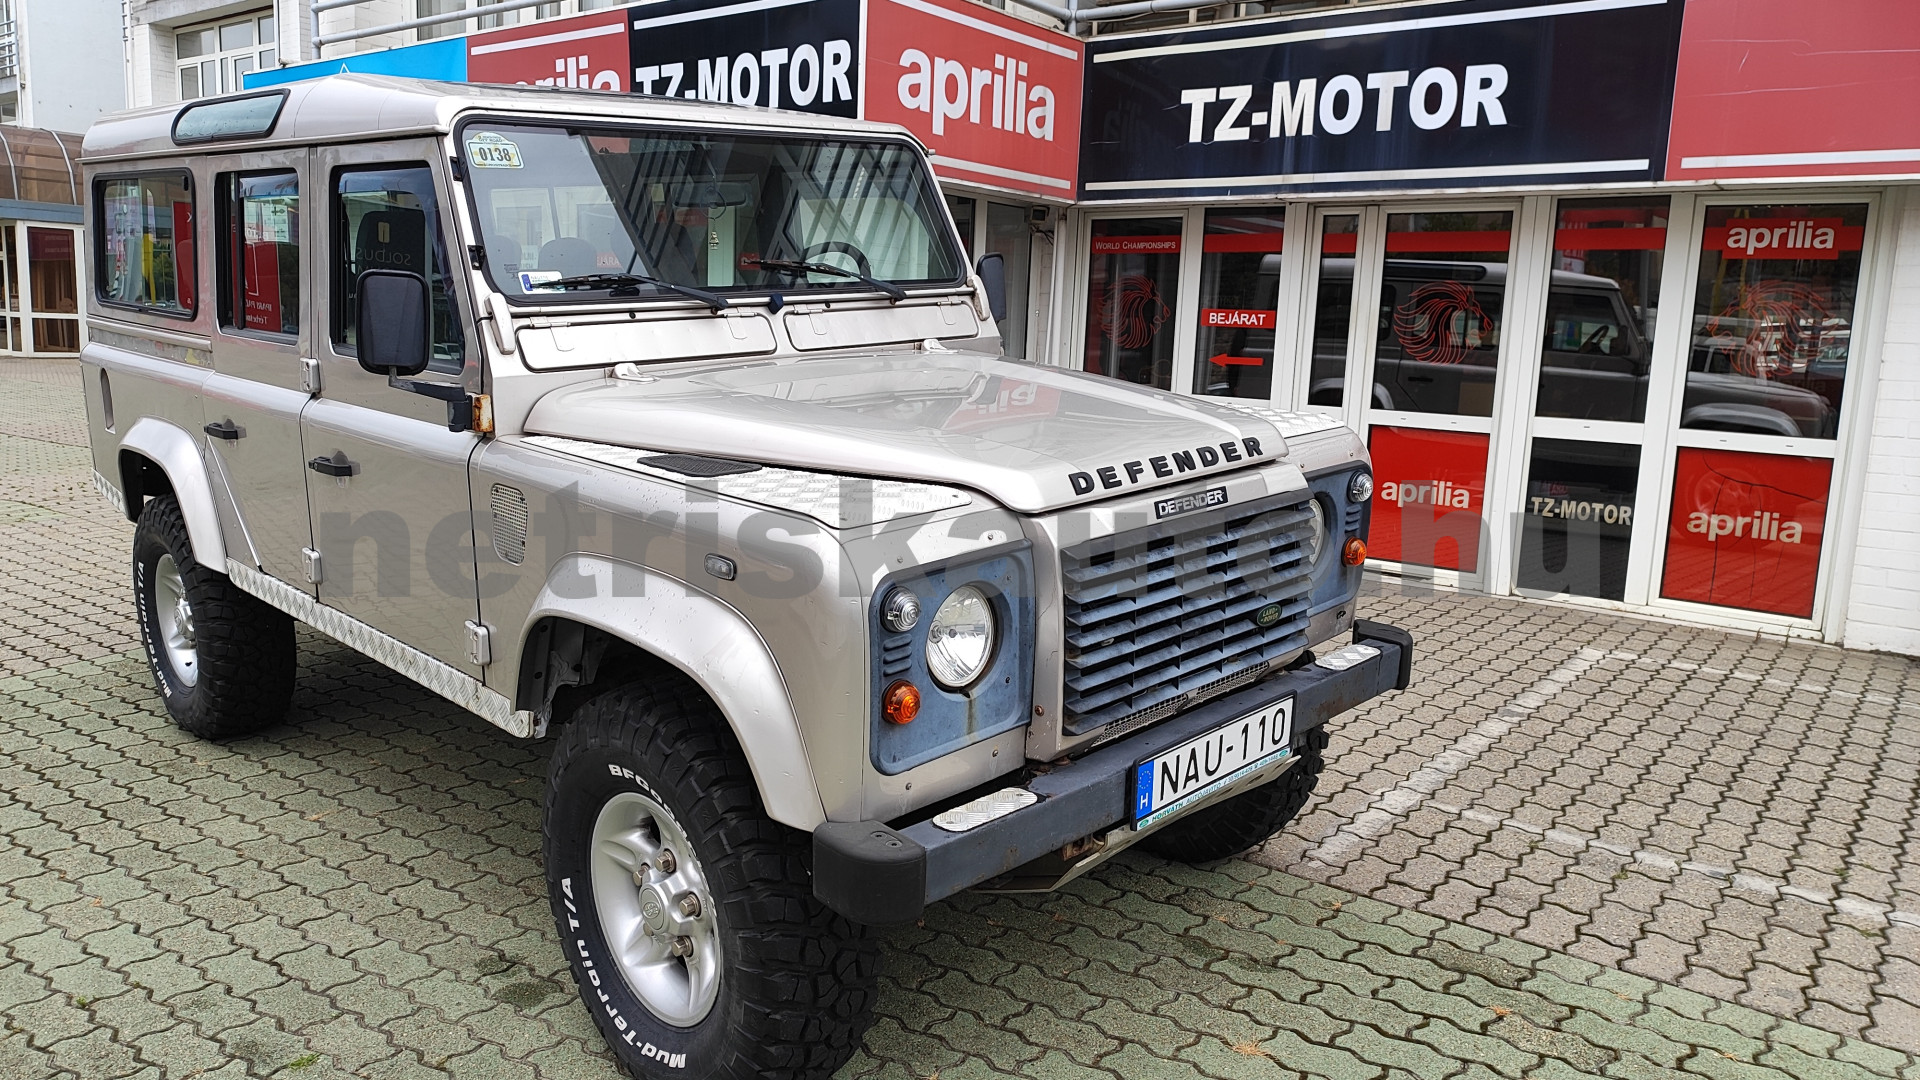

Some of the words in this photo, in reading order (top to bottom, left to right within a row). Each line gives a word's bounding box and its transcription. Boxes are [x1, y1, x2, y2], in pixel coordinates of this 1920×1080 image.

[635, 39, 853, 107] TZ-MOTOR
[897, 48, 1055, 142] aprilia
[1180, 64, 1509, 143] TZ-MOTOR
[479, 147, 512, 162] 0138
[1095, 241, 1120, 250] WORLD
[1122, 240, 1176, 250] CHAMPIONSHIPS
[1726, 221, 1835, 255] aprilia
[1208, 311, 1266, 326] BEJÁRAT
[1068, 436, 1264, 496] DEFENDER
[1158, 489, 1225, 516] DEFENDER
[1381, 480, 1470, 509] aprilia
[1530, 497, 1632, 526] TZ-MOTOR
[1686, 510, 1803, 544] aprilia
[139, 593, 172, 699] Mud-Terrain
[1160, 707, 1286, 801] NAU-110
[1139, 792, 1149, 810] H
[561, 877, 580, 932] T/A
[577, 939, 687, 1069] Mud-Terrain
